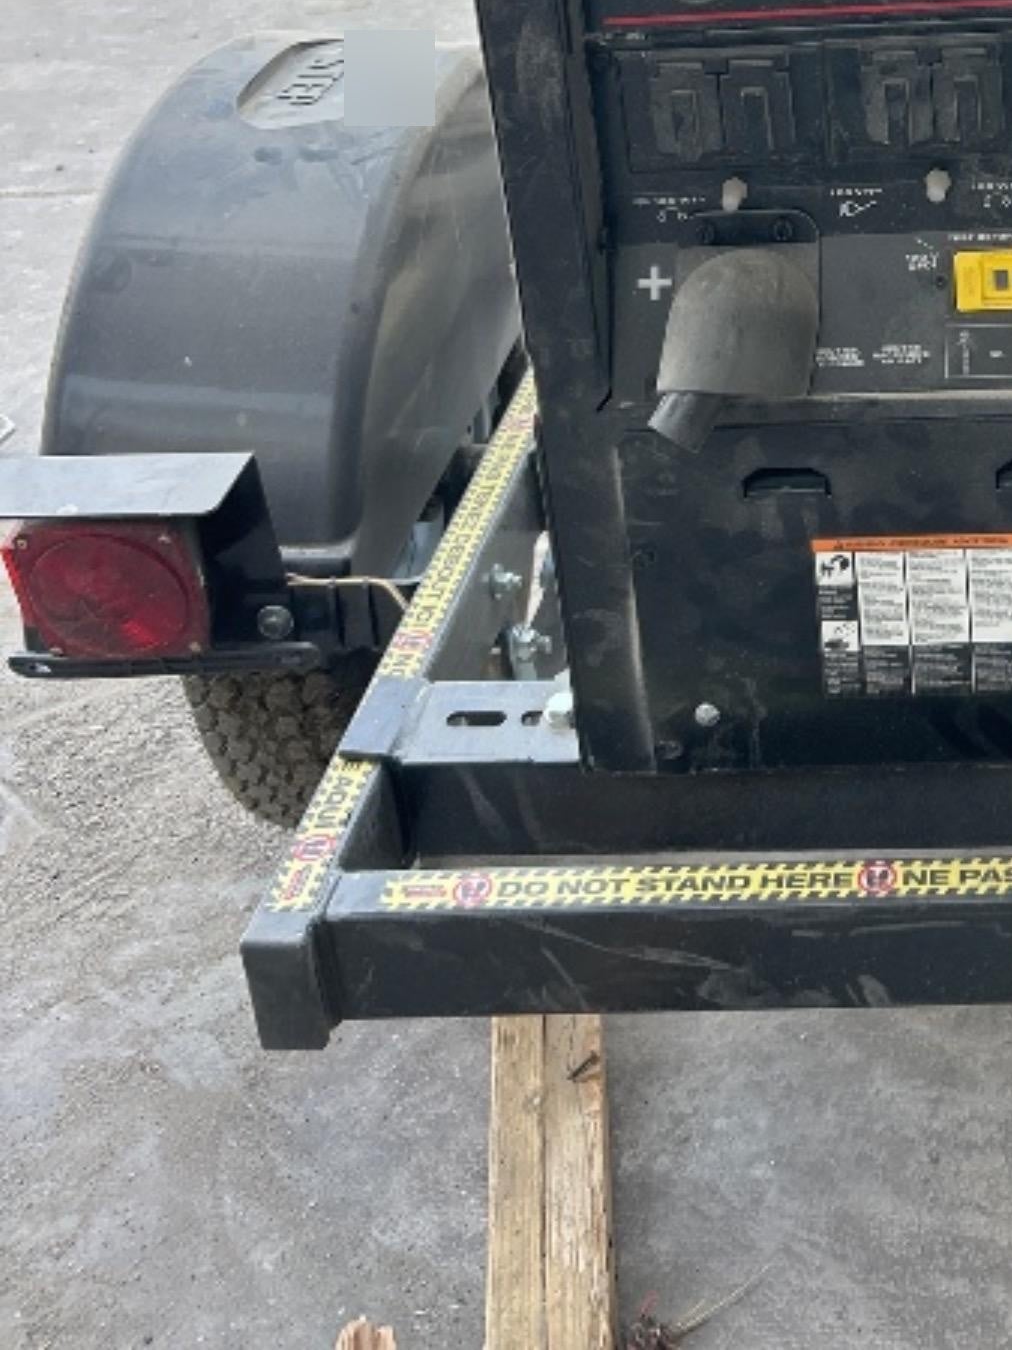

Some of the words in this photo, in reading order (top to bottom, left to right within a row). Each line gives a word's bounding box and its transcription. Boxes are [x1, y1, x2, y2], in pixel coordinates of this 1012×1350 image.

[498, 881, 549, 898] DO
[557, 878, 629, 895] NOT
[635, 872, 750, 892] STAND
[760, 872, 853, 889] HERE
[902, 869, 952, 886] NE
